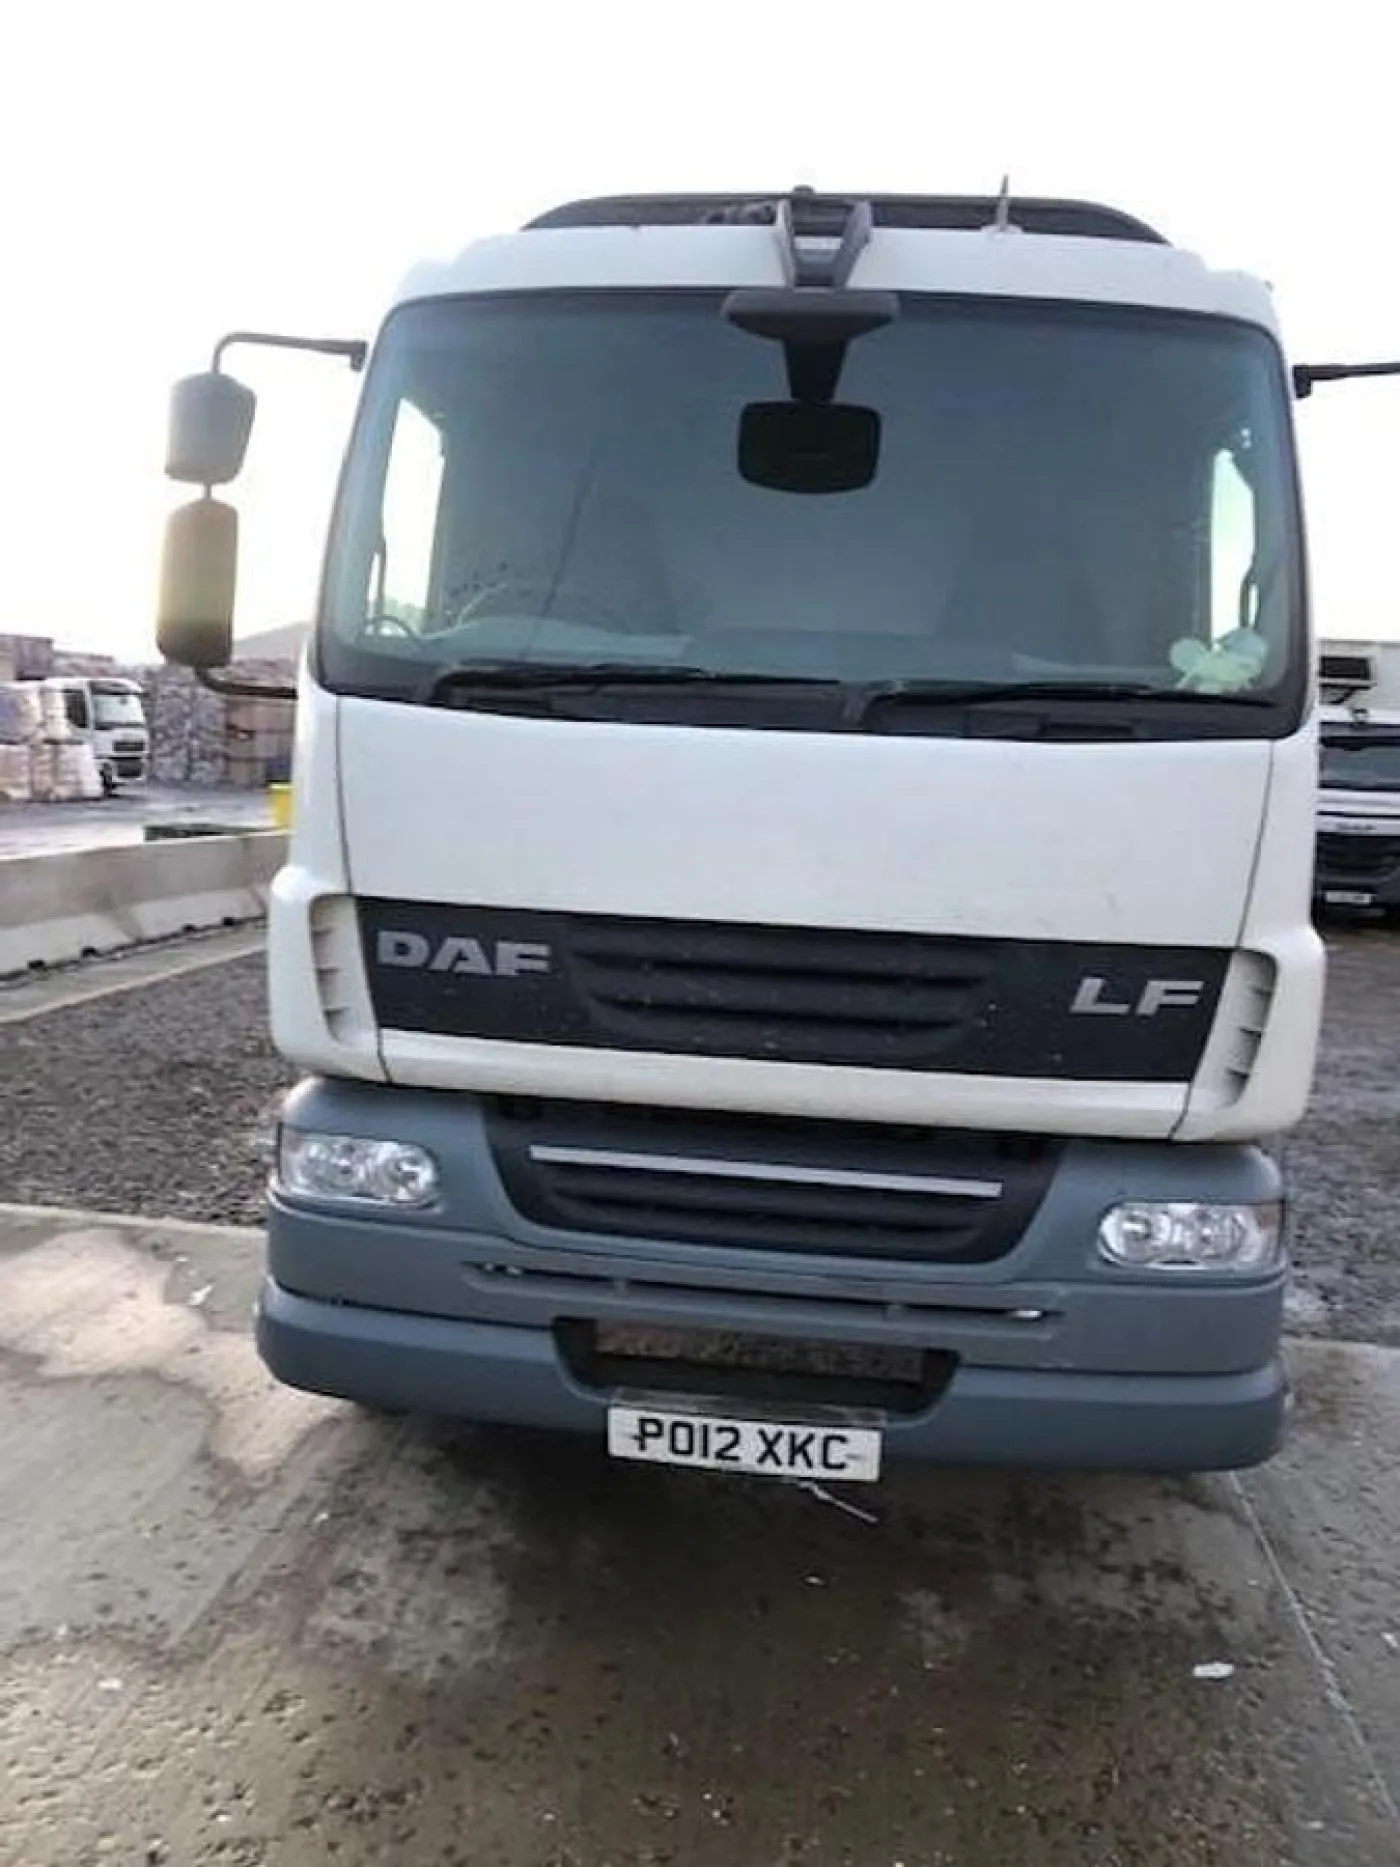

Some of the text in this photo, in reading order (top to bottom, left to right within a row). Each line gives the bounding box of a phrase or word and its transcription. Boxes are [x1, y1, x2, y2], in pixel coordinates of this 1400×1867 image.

[376, 930, 551, 976] DAF
[1069, 976, 1204, 1016] LF
[636, 1416, 848, 1470] PO12 XKC
